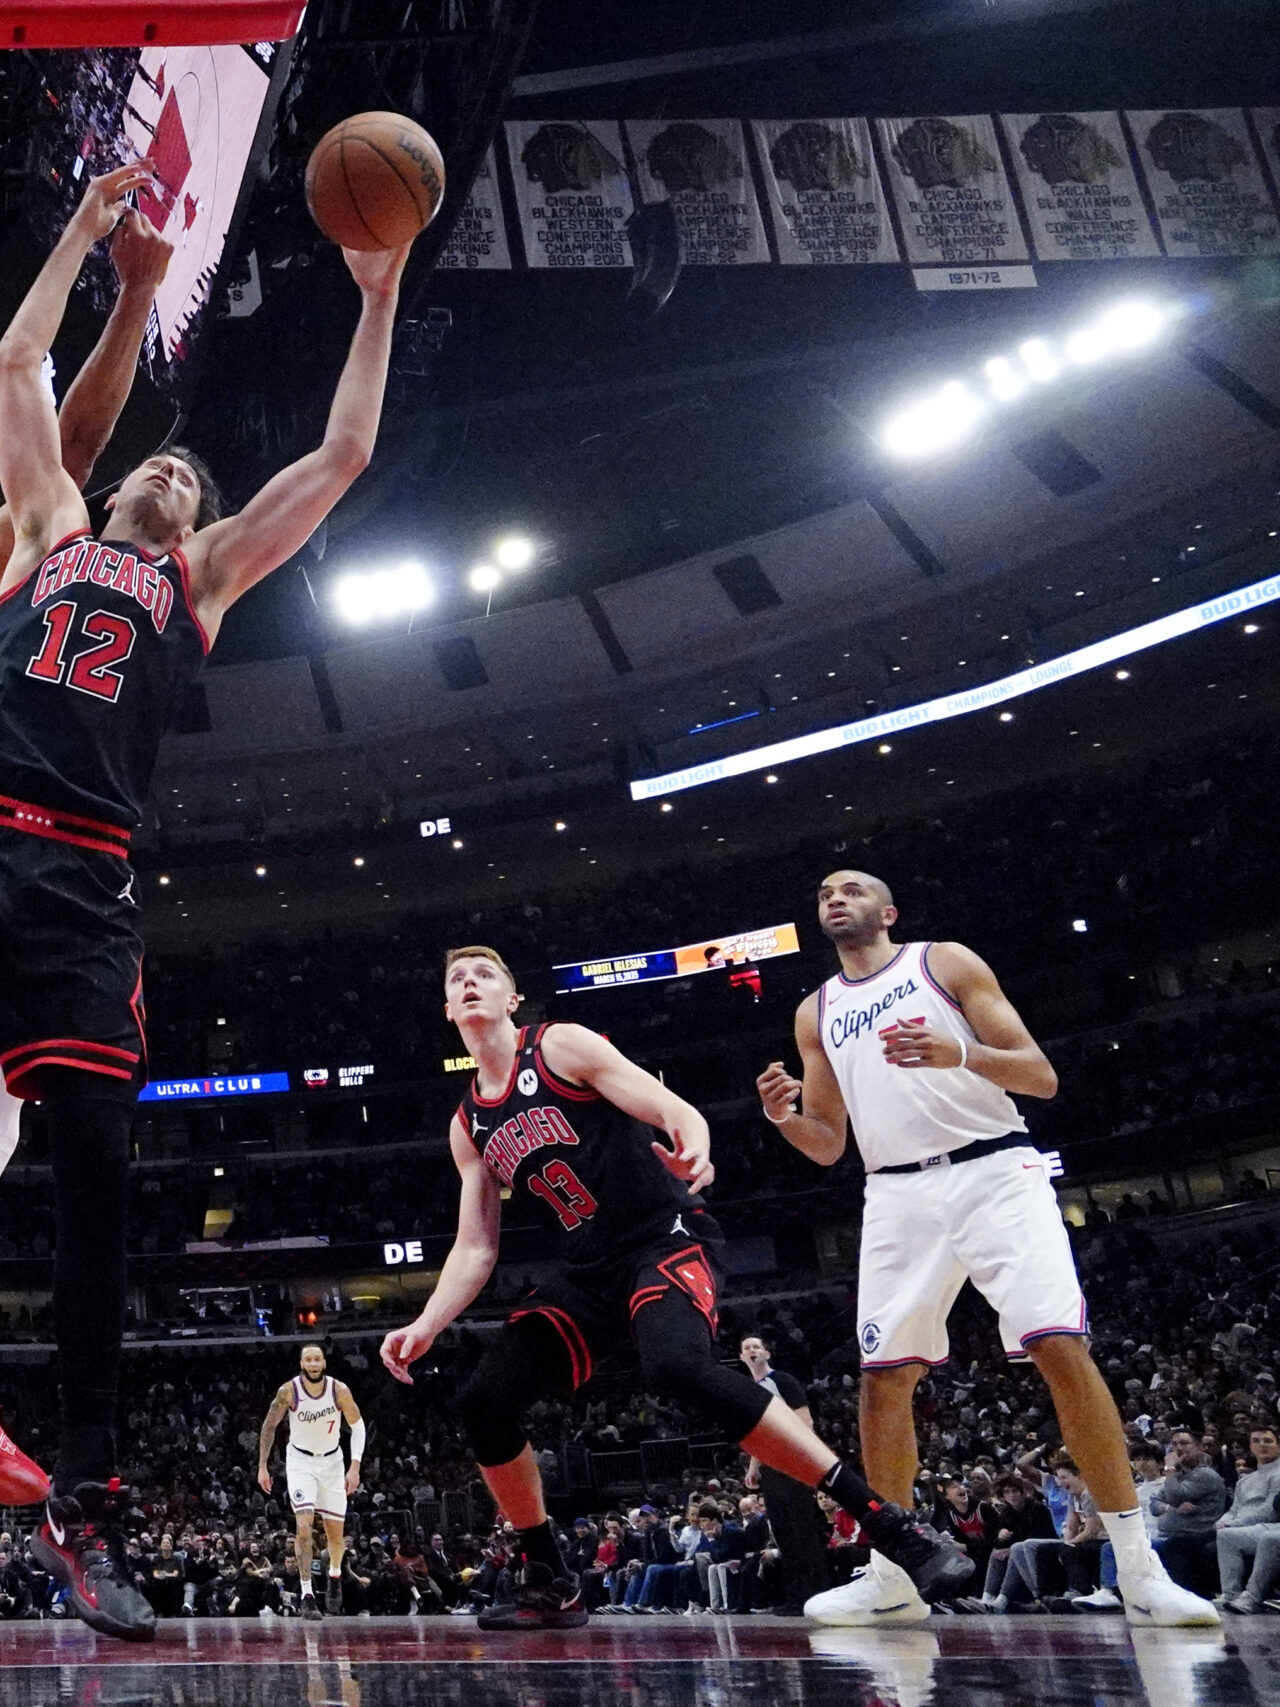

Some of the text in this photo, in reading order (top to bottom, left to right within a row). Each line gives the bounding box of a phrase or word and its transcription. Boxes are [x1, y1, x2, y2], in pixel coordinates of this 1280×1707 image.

[923, 188, 982, 201] CHICAGO
[1051, 184, 1110, 196] CHICAGO
[545, 196, 603, 207] CHICAGO
[796, 192, 856, 204] CHICAGO
[1036, 196, 1131, 209] BLACKHAWKS
[532, 207, 624, 219] BLACKHAWKS
[783, 203, 876, 216] BLACKHAWKS
[909, 200, 1004, 213] BLACKHAWKS
[793, 215, 865, 227] CAMPBELL
[921, 212, 996, 224] CAMPBELL
[546, 219, 614, 231] WESTERN
[916, 223, 1009, 236] CONFERENCE
[1045, 220, 1138, 234] CONFERENCE
[537, 231, 628, 242] CONFERENCE
[790, 227, 880, 239] CONFERENCE
[798, 239, 877, 250] CHAMPIONS
[925, 236, 1006, 248] CHAMPIONS
[1055, 234, 1136, 246] CHAMPIONS
[545, 242, 624, 254] CHAMPIONS
[548, 254, 625, 266] 2009-2010
[948, 272, 1002, 284] 1971-72
[32, 541, 173, 633] CHICAGO
[1200, 595, 1241, 622] BUD
[25, 600, 137, 703] 12
[843, 658, 1074, 742] BUD LIGHT CHAMPIONS LOUNGE
[646, 764, 725, 795] BUD LIGHT
[420, 818, 451, 837] DE
[582, 957, 648, 976] GABRIEL IGLESIAS
[830, 978, 919, 1049] Clippers
[338, 1065, 374, 1077] CLIPPERS
[157, 1078, 262, 1096] ULTRA CLUB
[483, 1106, 580, 1189] CHICAGO
[527, 1159, 598, 1231] 13
[384, 1241, 424, 1265] DE
[298, 1406, 336, 1424] Clippers
[327, 1420, 335, 1434] 7
